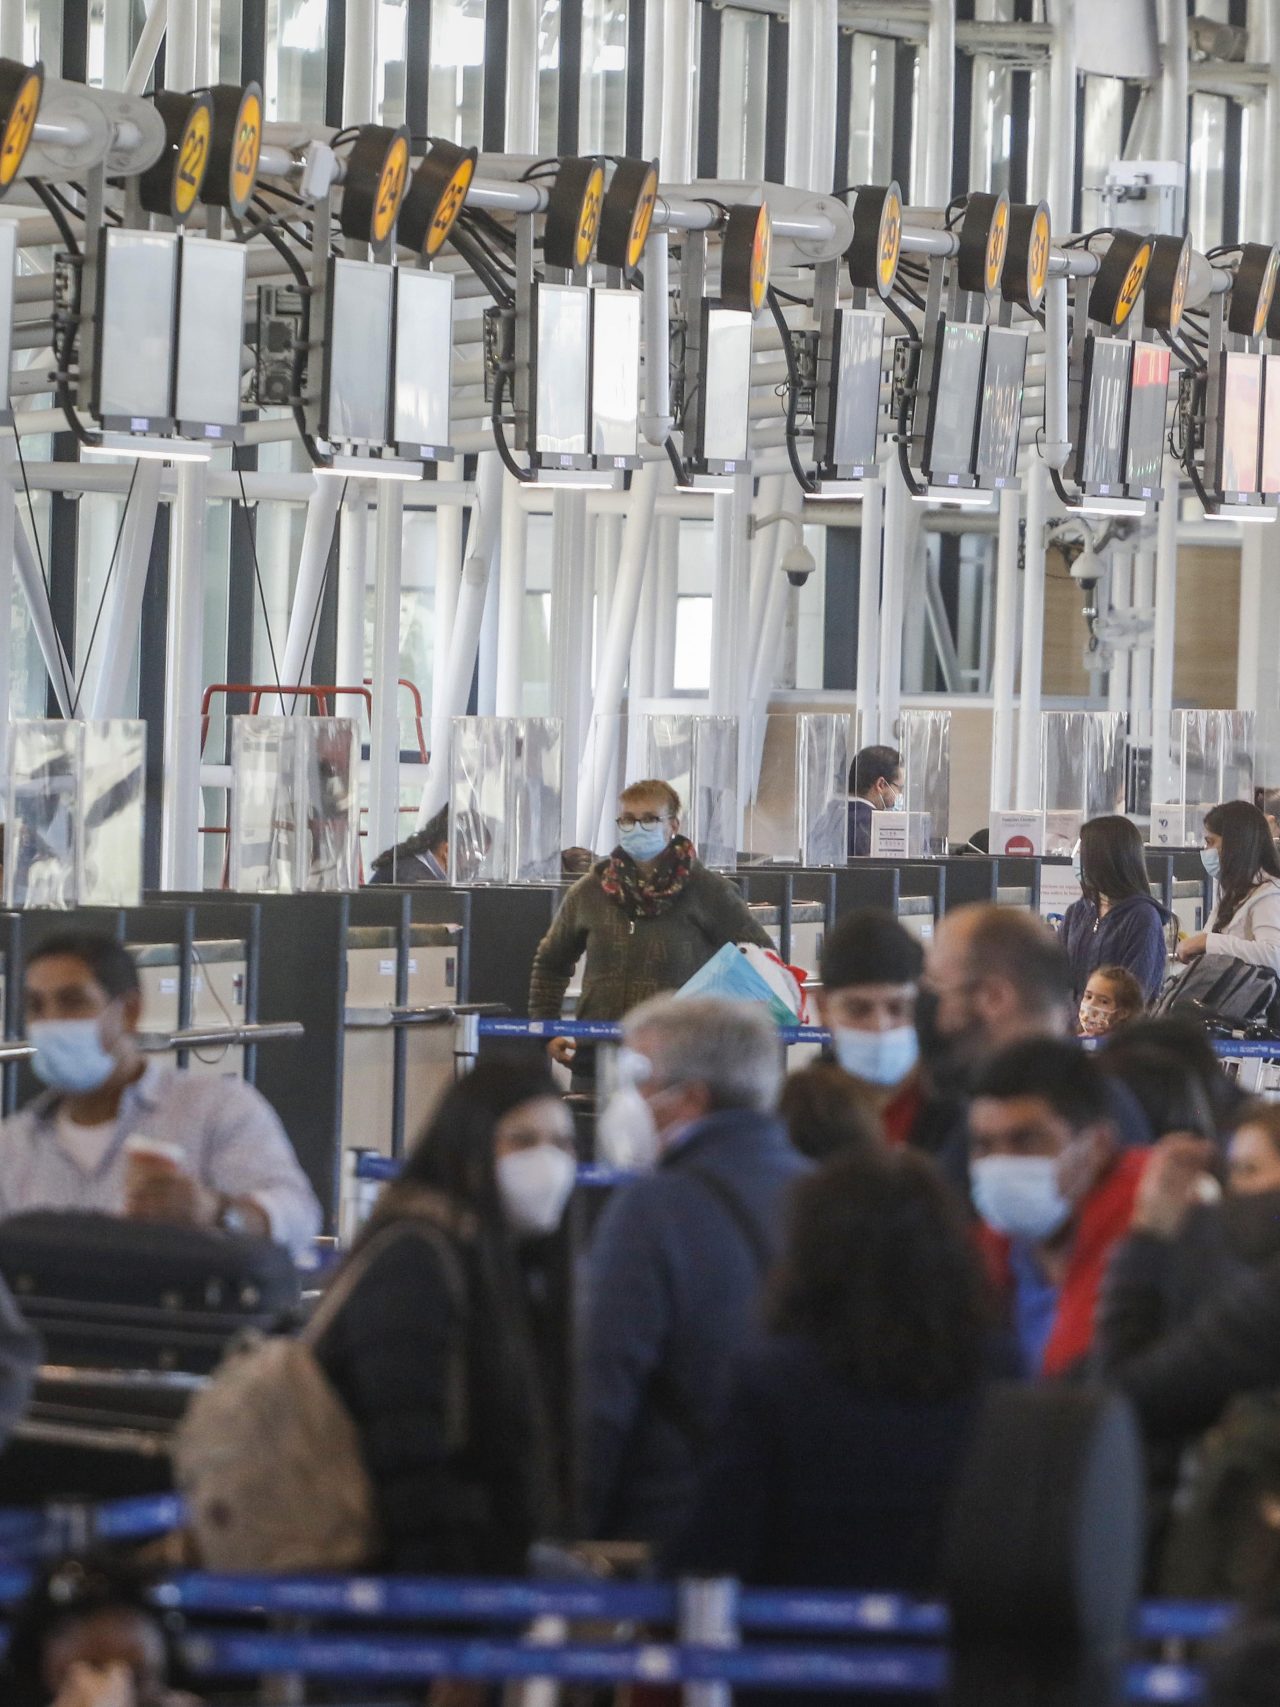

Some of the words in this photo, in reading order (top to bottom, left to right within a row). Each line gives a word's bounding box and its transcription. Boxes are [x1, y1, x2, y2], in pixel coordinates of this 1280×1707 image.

[177, 129, 205, 187] 22
[377, 162, 403, 215] 24
[433, 183, 463, 230] 25
[1032, 234, 1046, 278] 31
[1120, 264, 1143, 304] 32
